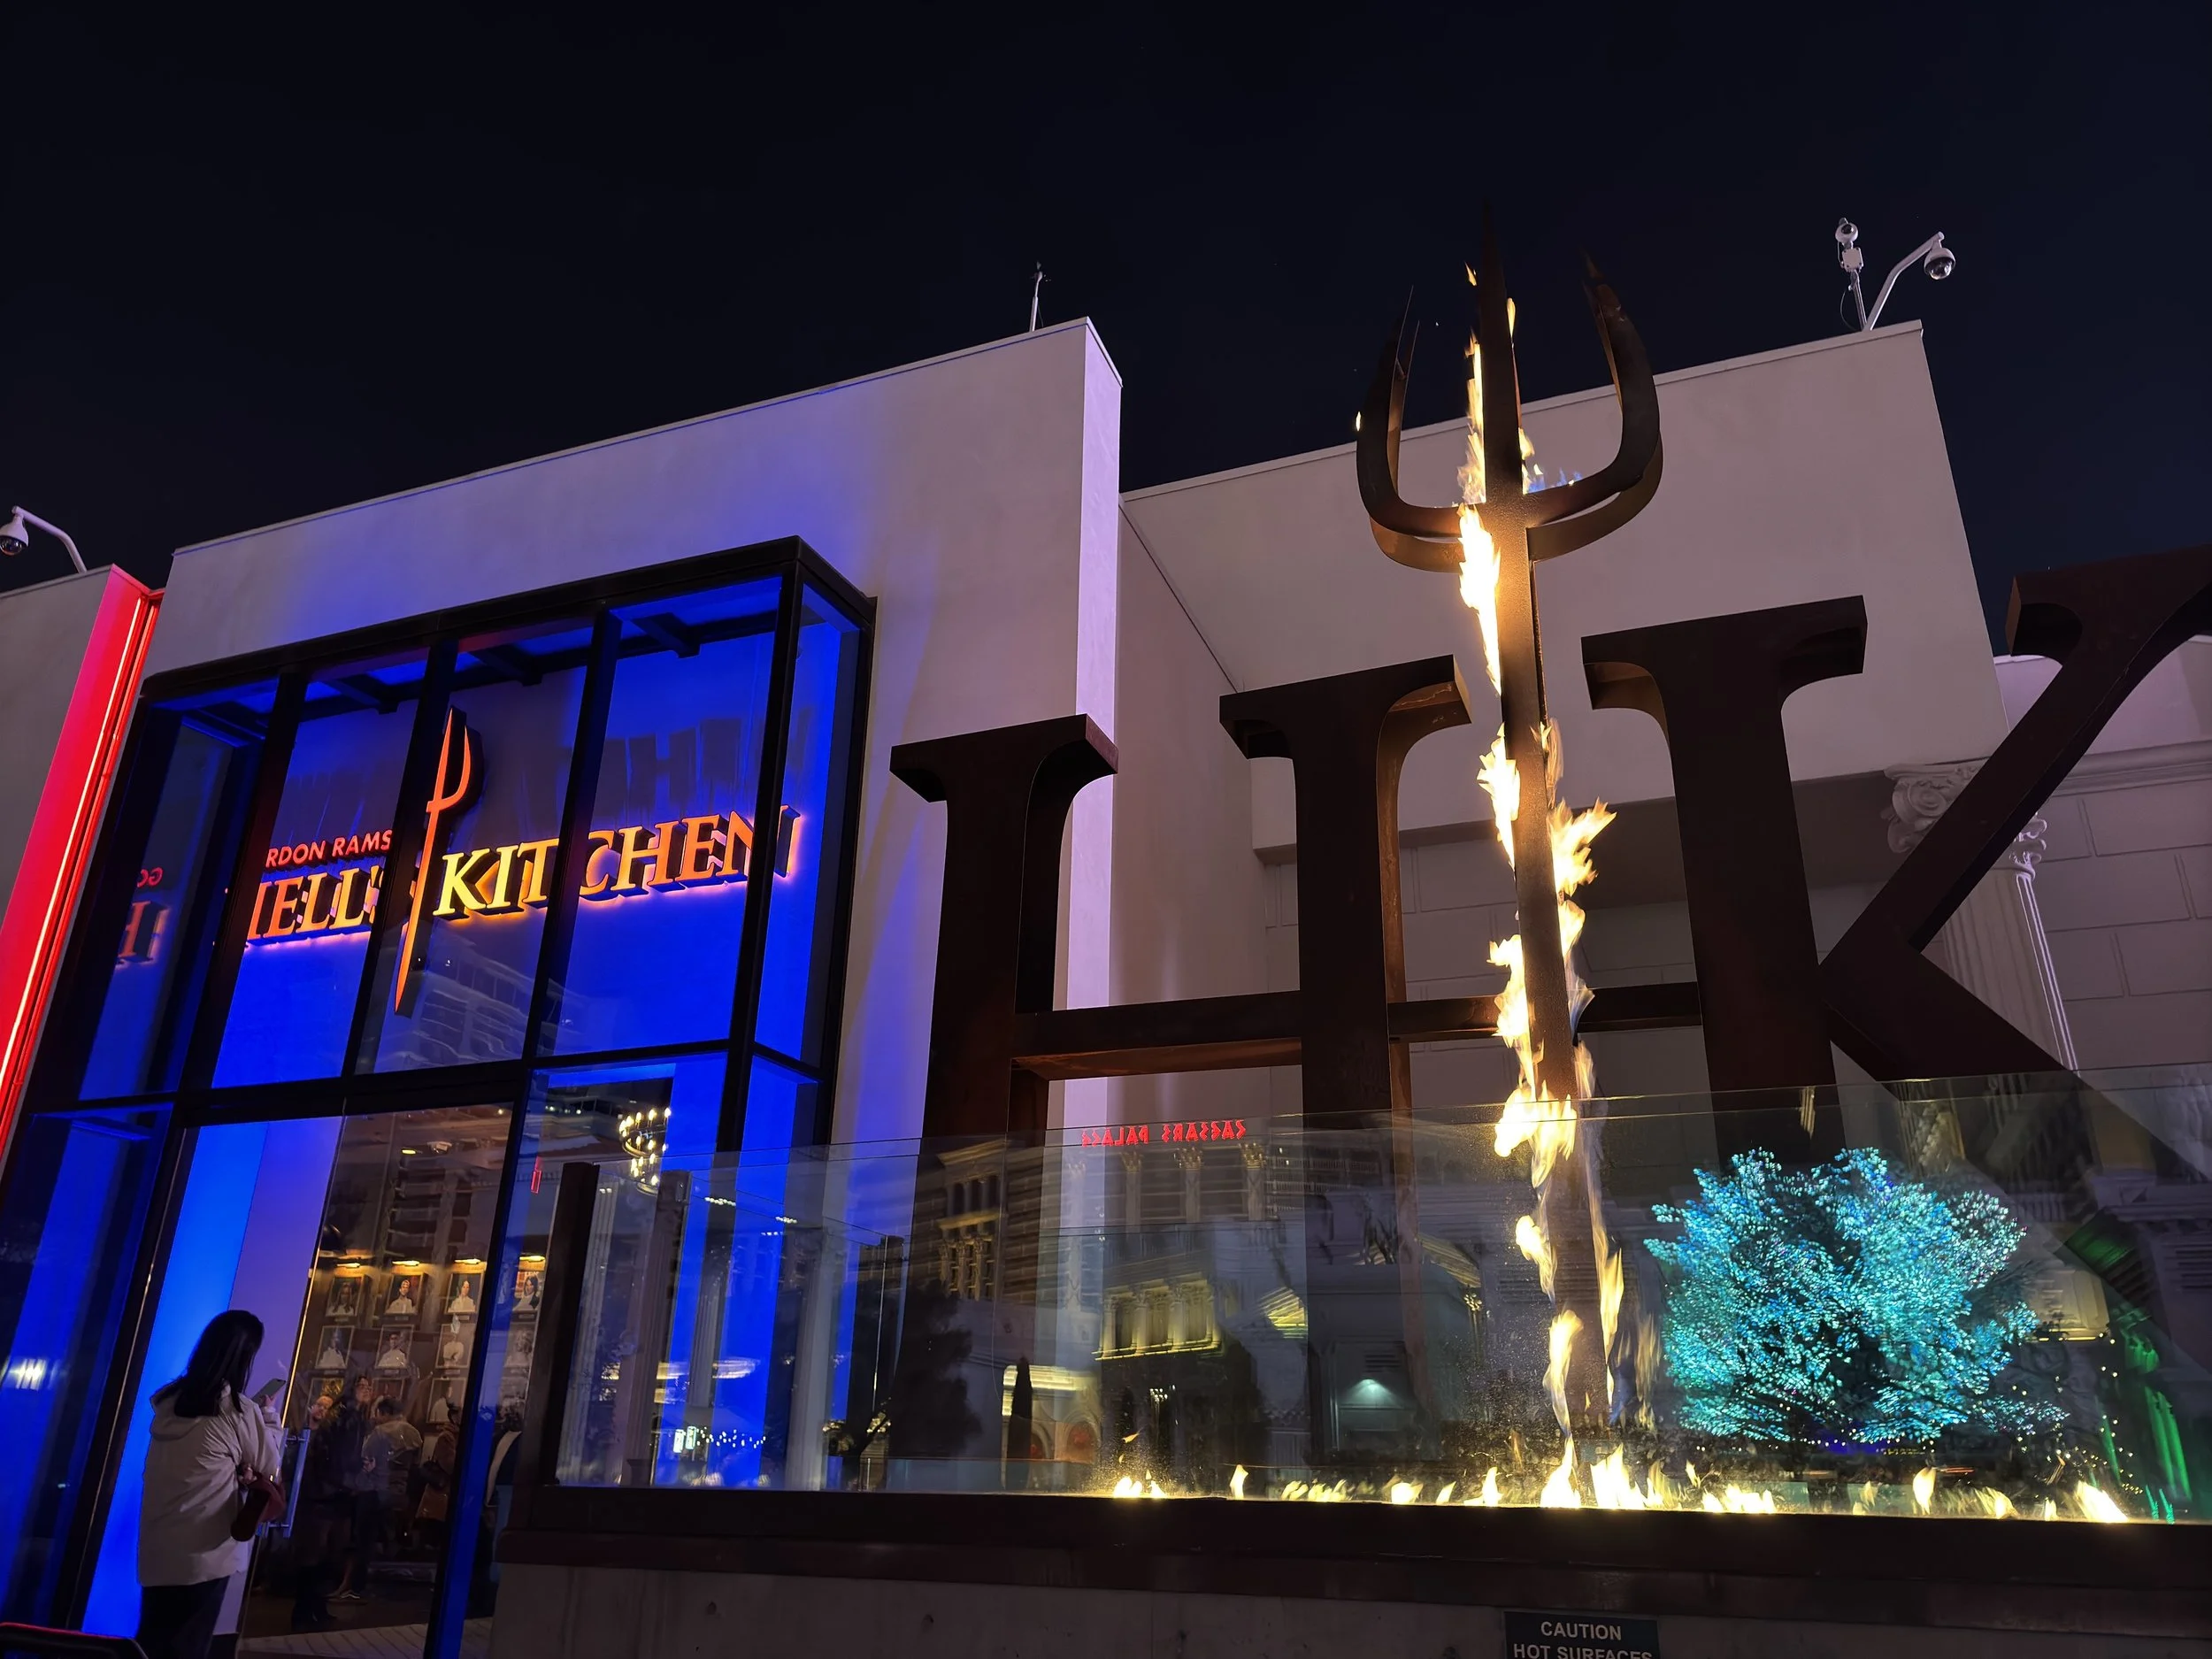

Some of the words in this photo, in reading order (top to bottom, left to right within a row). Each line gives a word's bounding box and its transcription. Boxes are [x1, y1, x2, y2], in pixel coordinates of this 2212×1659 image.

[265, 841, 326, 868] RDON
[332, 829, 393, 857] RAMS
[247, 864, 384, 941] ELL'
[433, 805, 791, 917] KITCHEN
[1540, 1621, 1622, 1641] CAUTION
[1513, 1643, 1551, 1659] HOT
